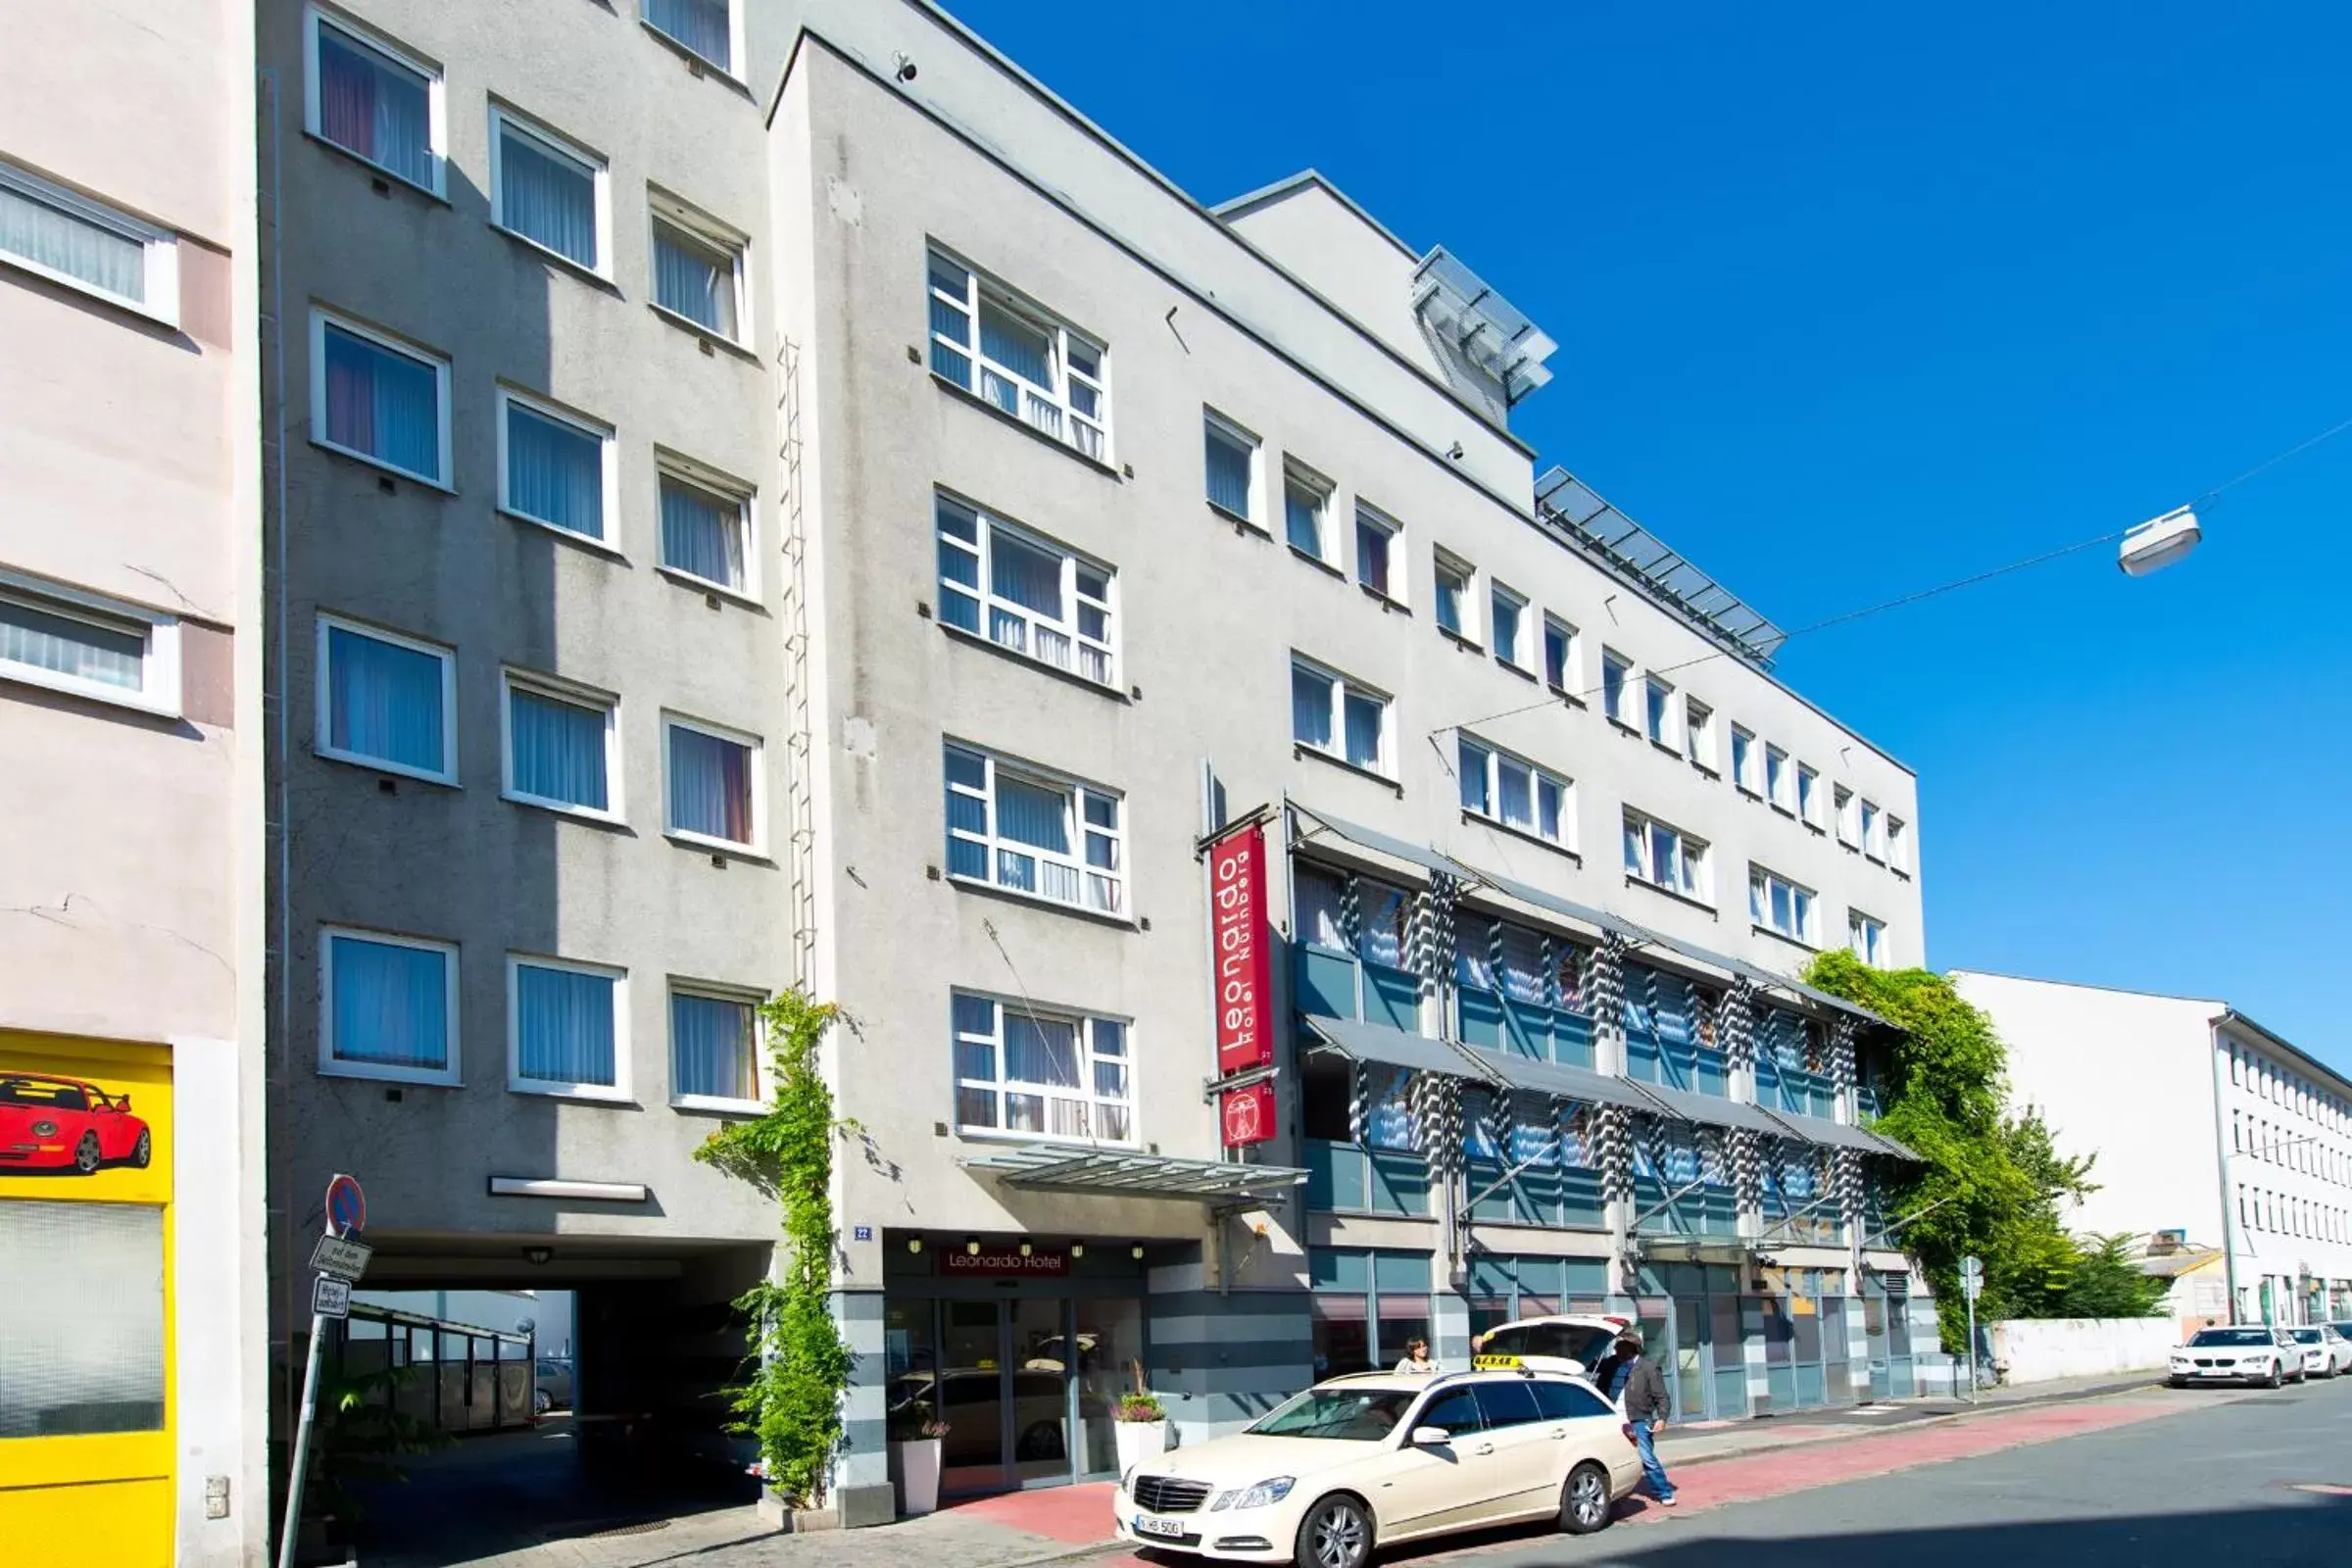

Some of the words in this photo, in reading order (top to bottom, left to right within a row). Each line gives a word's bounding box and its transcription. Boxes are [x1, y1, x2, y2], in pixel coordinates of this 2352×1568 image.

[1216, 858, 1244, 1051] Leonardo
[1241, 983, 1254, 1043] Hotel
[949, 1253, 1022, 1268] Leonardo
[1024, 1255, 1061, 1269] Hotel
